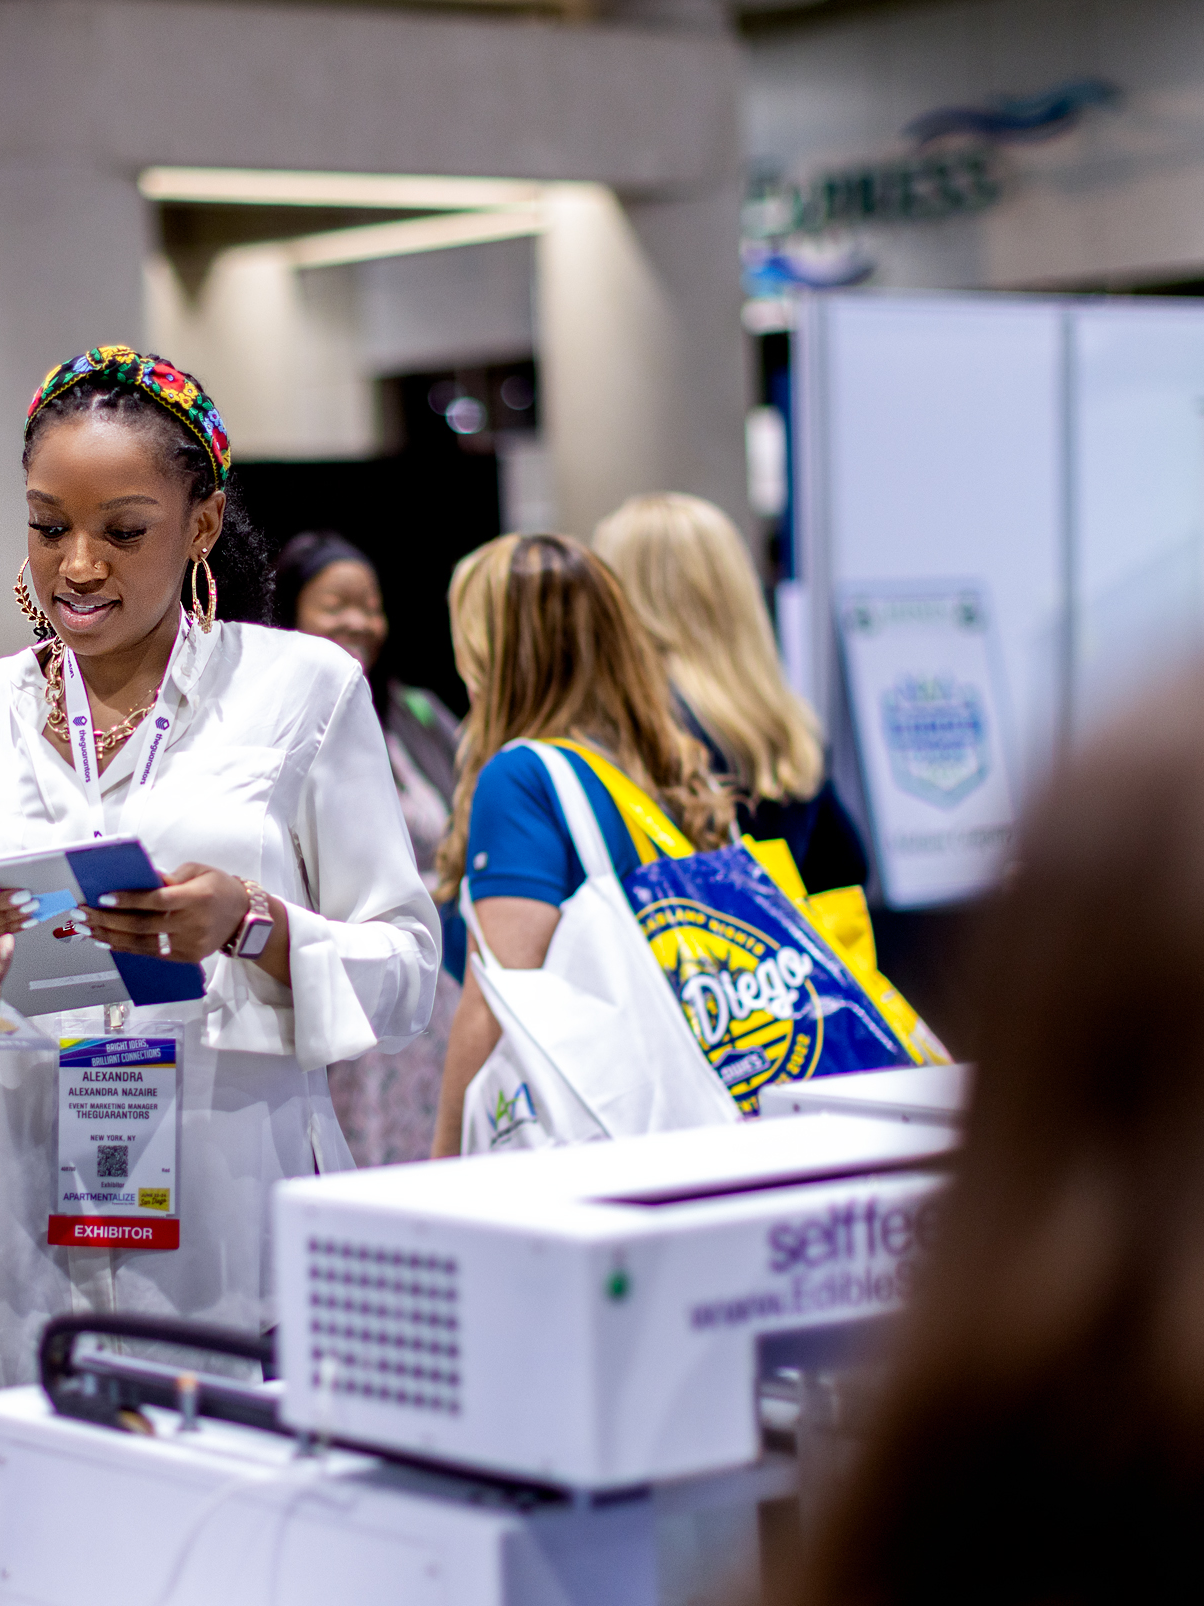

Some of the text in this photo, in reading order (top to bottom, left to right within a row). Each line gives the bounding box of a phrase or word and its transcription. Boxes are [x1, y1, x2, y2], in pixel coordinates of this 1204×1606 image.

[79, 729, 91, 783] theguarantors
[140, 733, 163, 785] theguarantors
[680, 946, 814, 1046] Diego
[106, 1039, 149, 1053] BRIGHT IDEAS,
[91, 1048, 161, 1067] BRILLIANT CONNECTIONS
[82, 1071, 144, 1082] ALEXANDRA
[68, 1087, 158, 1097] ALEXANDRA NAZAIRE
[76, 1110, 150, 1119] THEGUARANTORS
[63, 1192, 136, 1202] APARTMENTALIZE
[74, 1225, 153, 1240] EXHIBITOR
